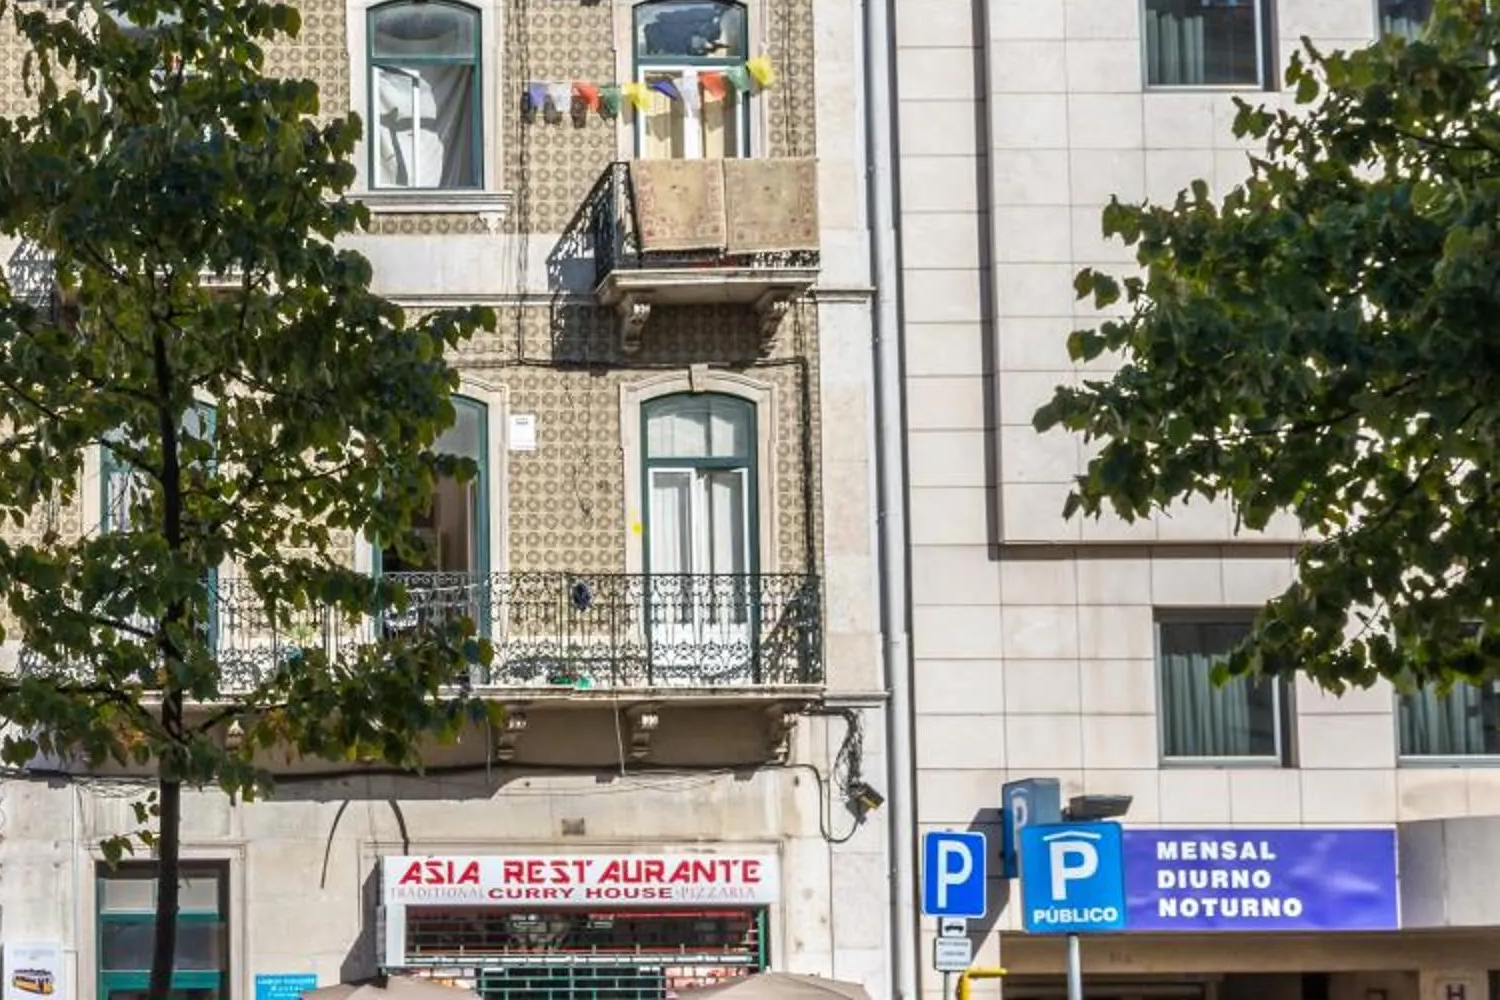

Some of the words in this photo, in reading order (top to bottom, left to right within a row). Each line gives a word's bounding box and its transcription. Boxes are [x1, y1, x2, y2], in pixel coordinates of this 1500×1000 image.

[1156, 840, 1277, 861] MENSAL
[398, 860, 481, 885] ASIA
[503, 859, 762, 884] RESTAURANTE
[937, 839, 973, 909] P
[1050, 841, 1099, 901] P
[1157, 869, 1272, 889] DIURNO
[487, 887, 575, 899] CURRY
[585, 887, 673, 899] HOUSE
[1033, 903, 1119, 925] PÚBLICO
[1158, 897, 1304, 917] NOTURNO
